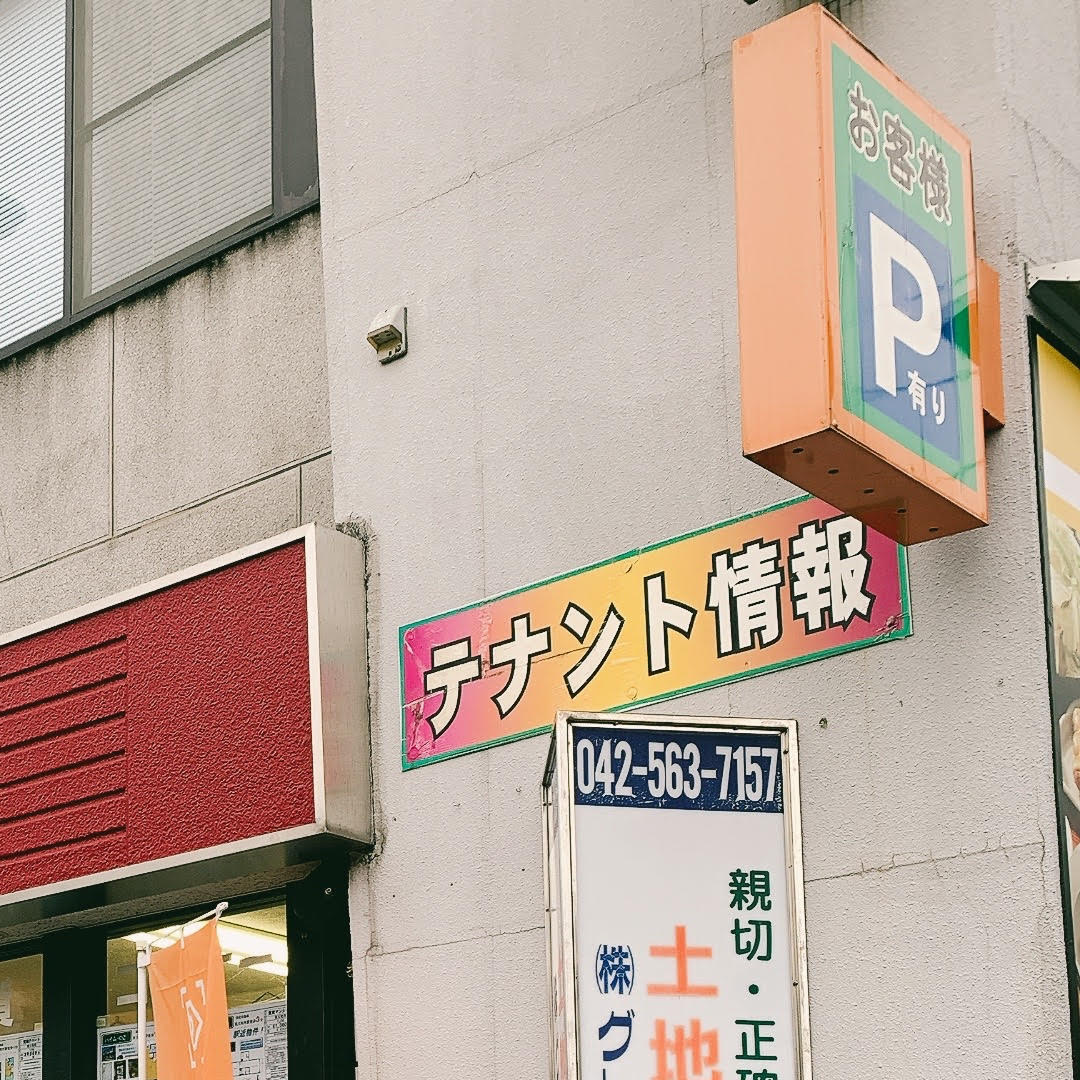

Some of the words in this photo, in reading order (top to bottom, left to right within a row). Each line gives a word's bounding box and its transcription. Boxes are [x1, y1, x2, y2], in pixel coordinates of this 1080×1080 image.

[848, 81, 951, 226] お客様
[869, 211, 942, 398] P
[907, 370, 946, 426] 有り
[424, 514, 877, 738] テナント情報
[577, 738, 779, 803] 042-563-7157
